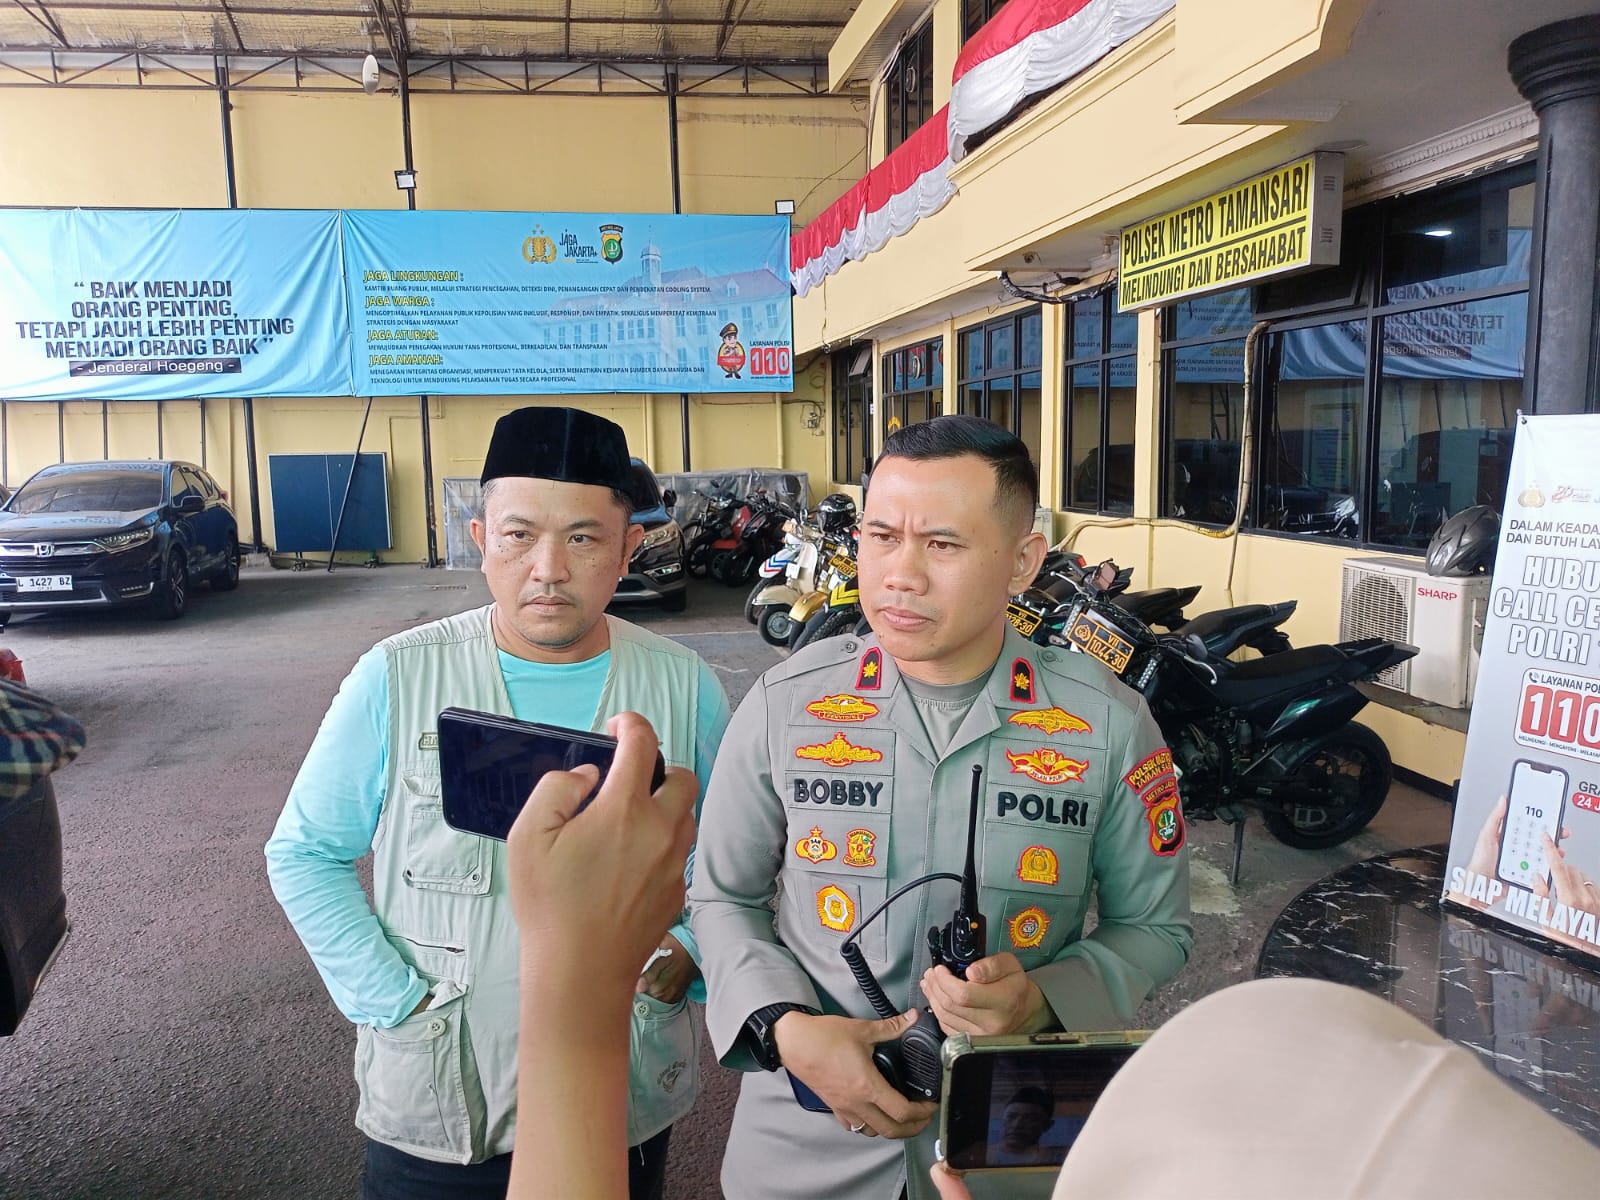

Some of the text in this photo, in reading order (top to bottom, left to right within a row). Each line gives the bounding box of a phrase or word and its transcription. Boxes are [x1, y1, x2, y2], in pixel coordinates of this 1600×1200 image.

[1124, 163, 1310, 269] POLSEK METRO TAMANSARI
[1122, 226, 1306, 306] MELINDUNGI DAN BERSAHABAT
[363, 271, 388, 283] JAGA
[391, 271, 459, 282] LINGKUNGAN
[91, 281, 138, 298] BAIK
[144, 280, 232, 298] MENJADI
[71, 300, 239, 319] ORANG PENTING,
[365, 296, 391, 309] JAGA
[392, 295, 430, 307] WARGA
[16, 318, 294, 339] TETAPI JAUH LEBIH PENTING
[367, 329, 439, 343] JAGA ATURAN:
[46, 340, 134, 358] MENJADI
[139, 339, 207, 357] ORANG
[88, 361, 152, 374] Jenderal
[157, 360, 224, 374] Hoegeng
[368, 355, 394, 367] JAGA
[752, 351, 789, 372] 110
[1510, 520, 1600, 535] DALAM KEADA
[1506, 533, 1533, 545] DAN
[1535, 535, 1578, 548] BUTUH
[18, 577, 71, 587] L 1427 BZ
[1417, 587, 1458, 601] SHARP
[1493, 587, 1558, 625] CALL
[1508, 624, 1592, 666] POLRI
[1541, 673, 1583, 691] LAYANAN
[794, 778, 884, 807] BOBBY
[1579, 781, 1600, 796] GR
[997, 791, 1089, 827] POLRI
[1577, 795, 1592, 808] 24
[1525, 806, 1543, 818] 110
[1450, 866, 1600, 947] SIAP MELAYA
